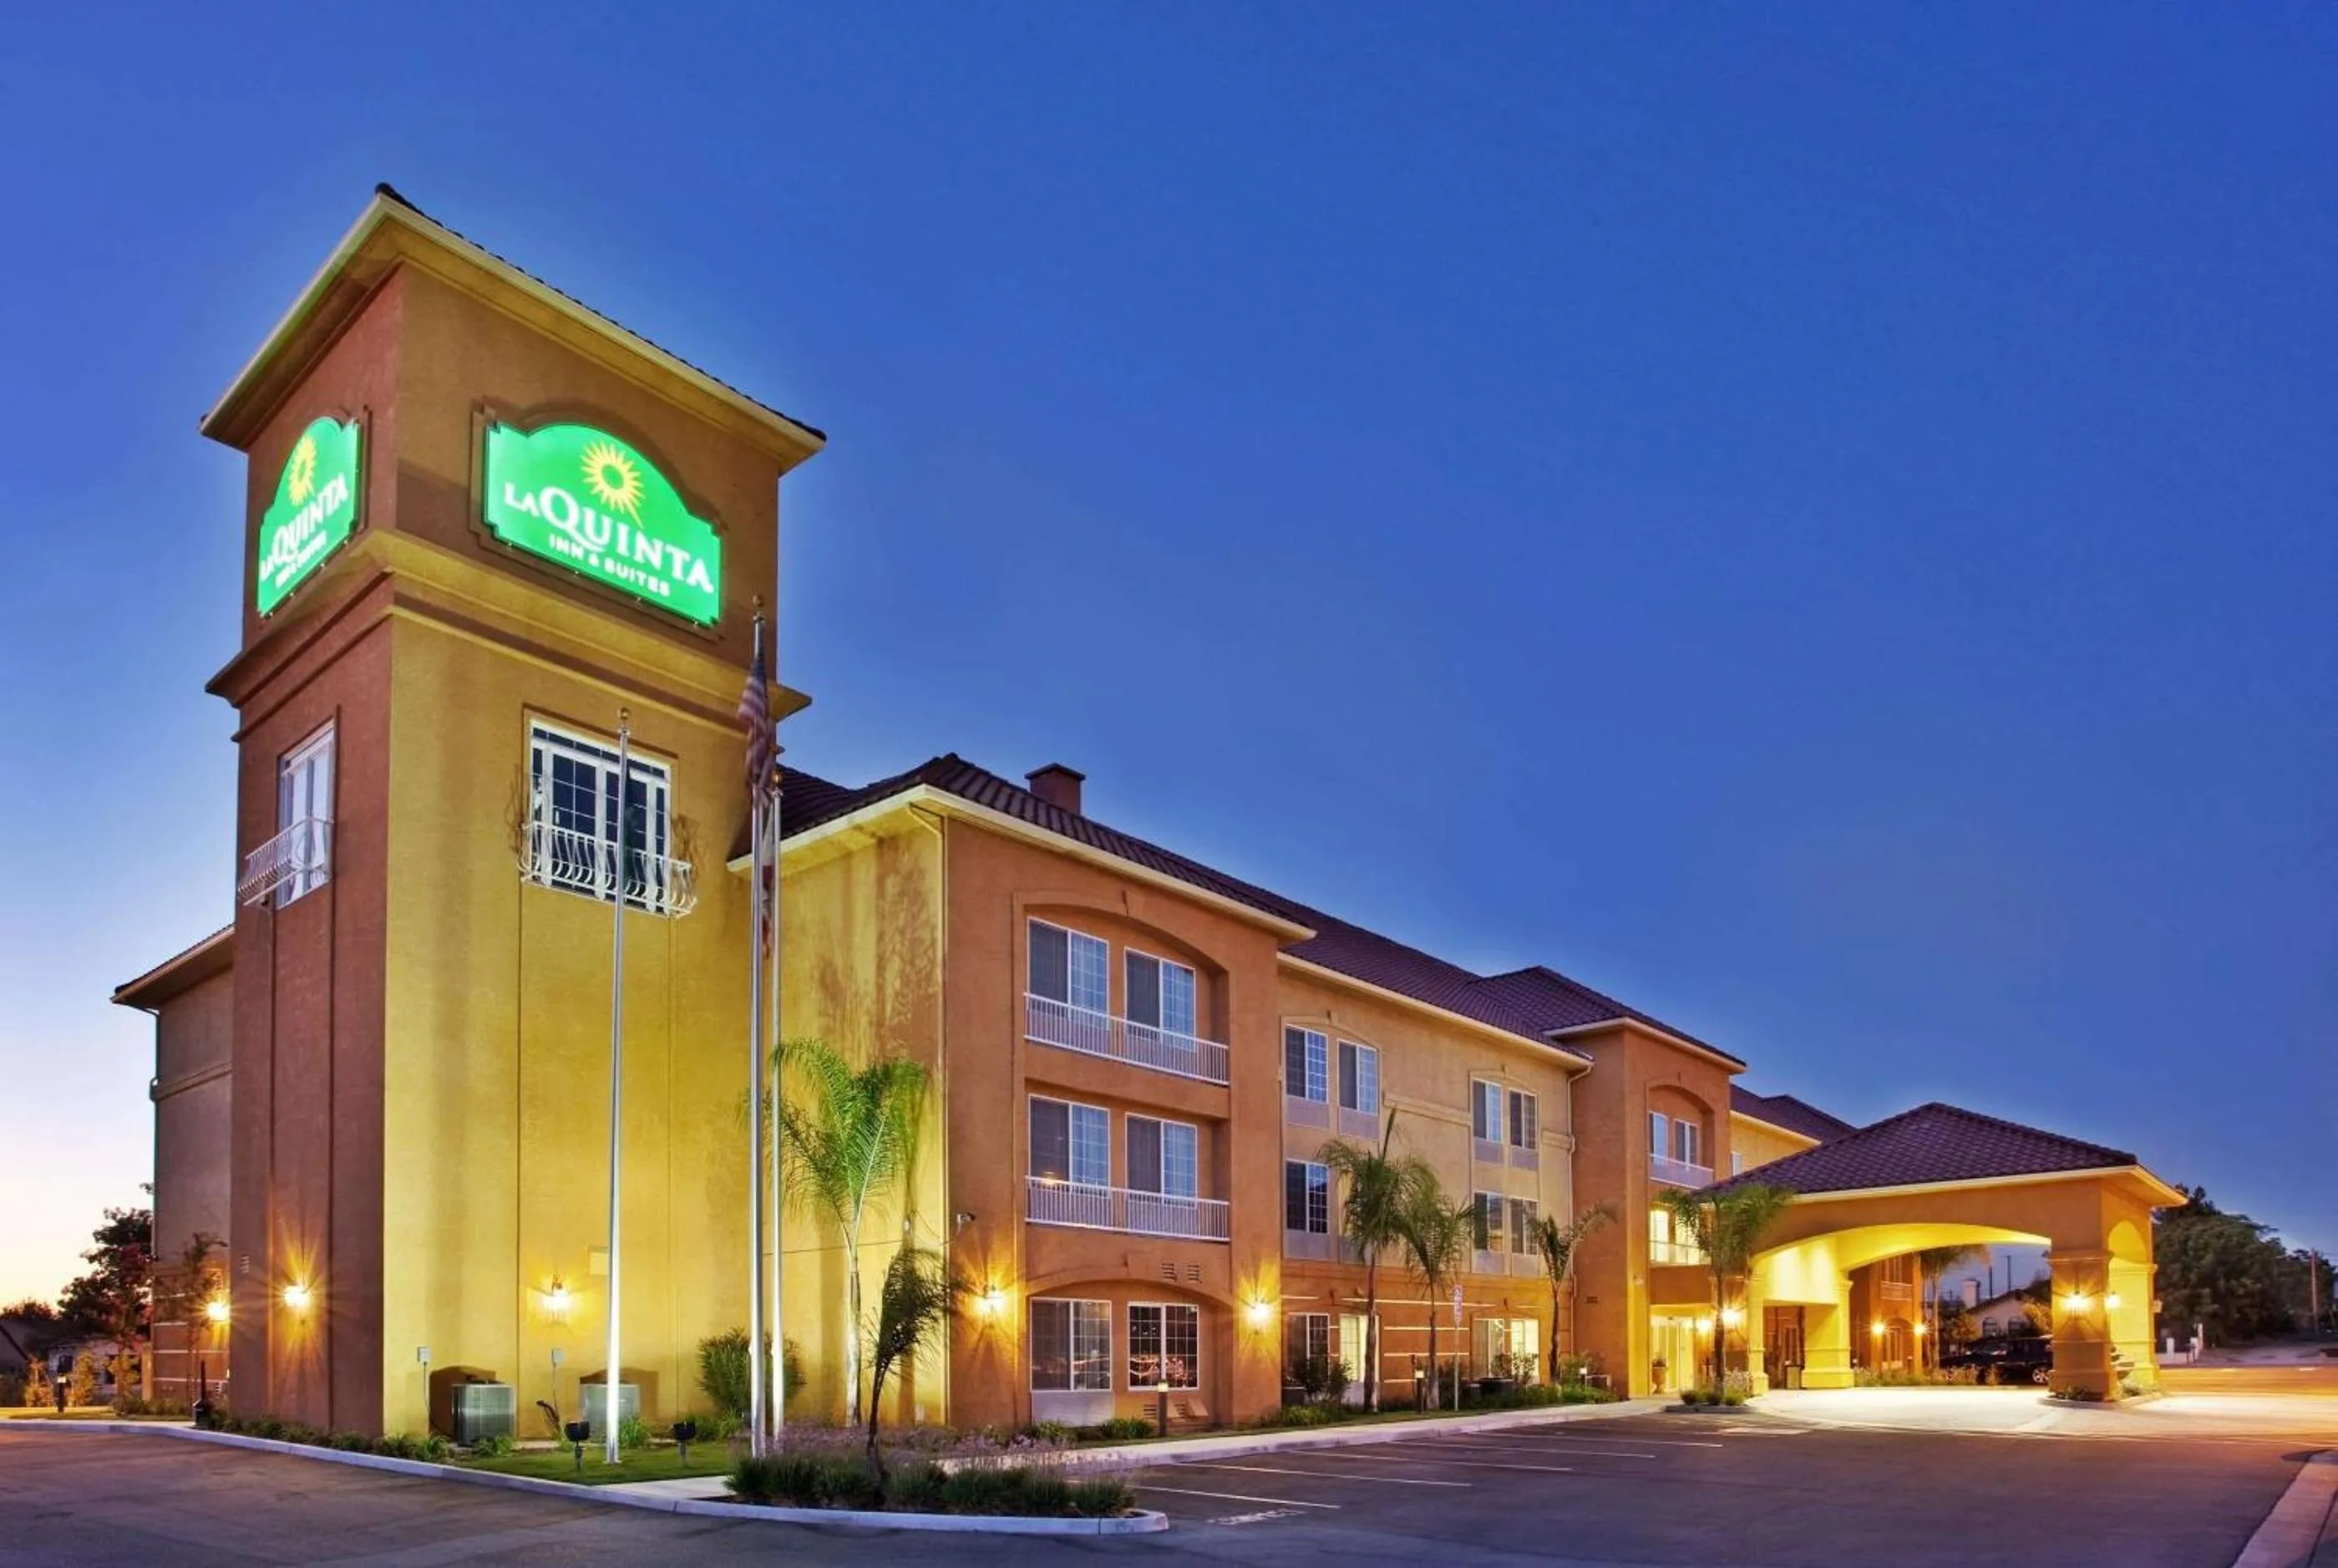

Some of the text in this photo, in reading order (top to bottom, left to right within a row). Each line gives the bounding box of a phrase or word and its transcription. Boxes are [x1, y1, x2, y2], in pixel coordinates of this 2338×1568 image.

[271, 472, 348, 565] QUINTA
[504, 482, 714, 594] LA QUINTA
[548, 534, 584, 561] INN
[604, 557, 671, 596] SUITES
